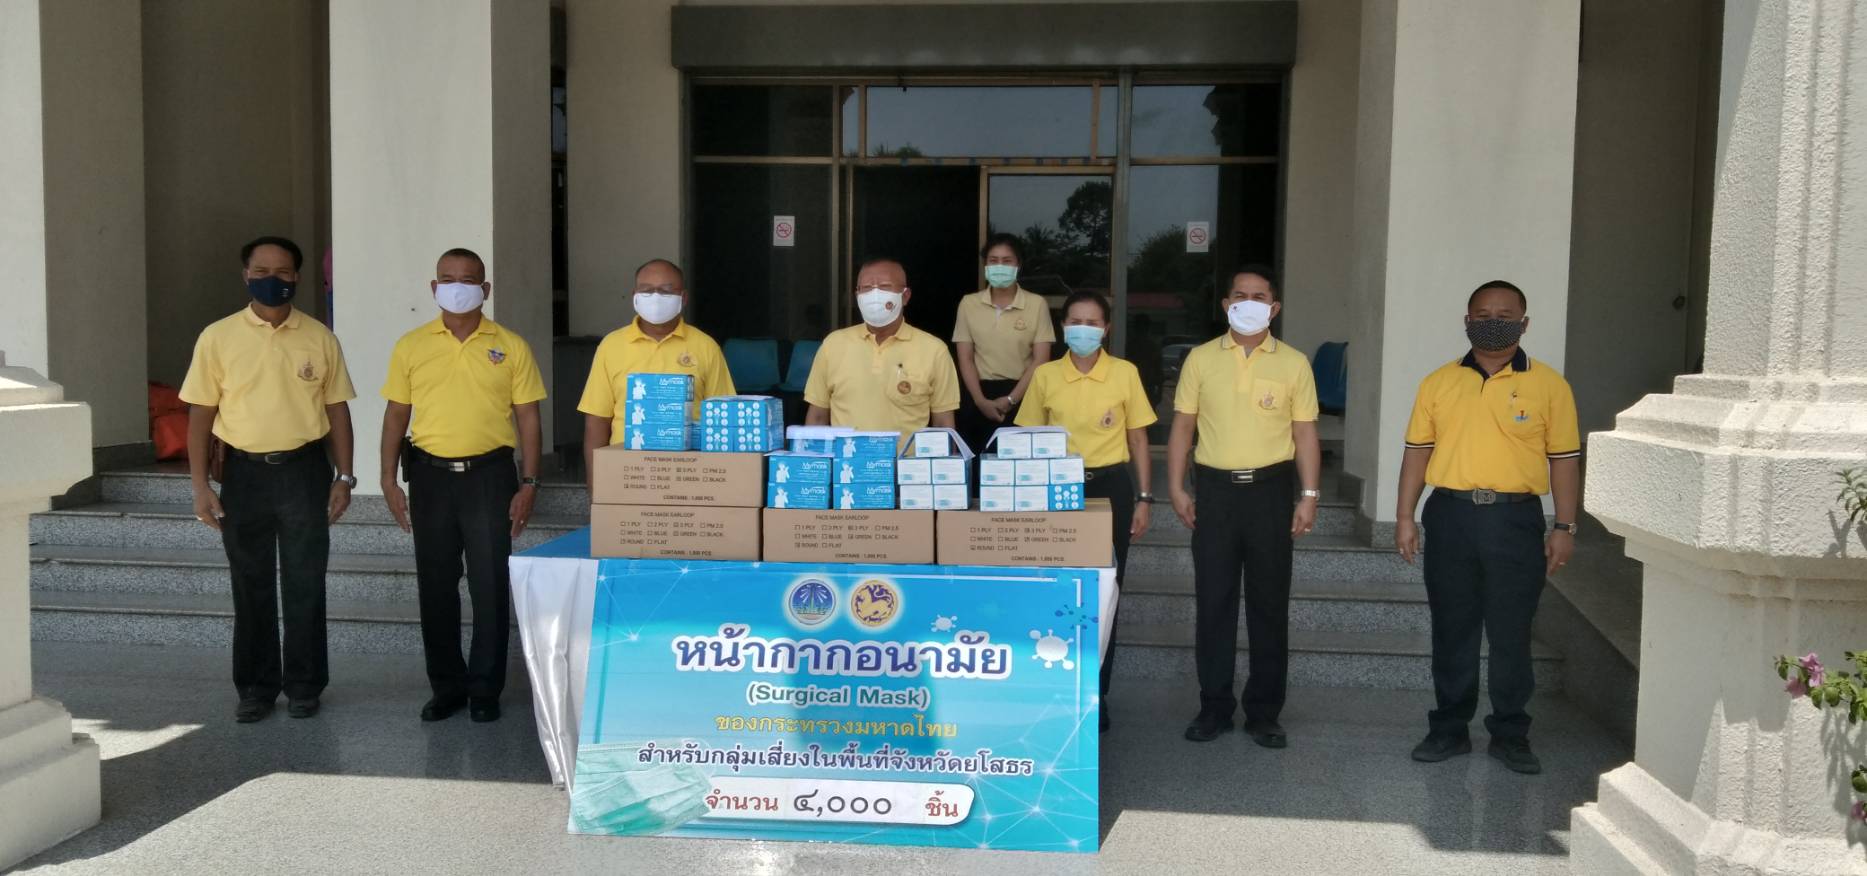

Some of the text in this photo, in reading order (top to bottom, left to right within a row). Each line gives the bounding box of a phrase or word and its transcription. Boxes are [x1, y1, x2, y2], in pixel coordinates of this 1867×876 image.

[677, 627, 1008, 674] หน้ากากอนามัย
[749, 684, 929, 708] (Surgical Mask)
[716, 714, 957, 737] ของกระทรวงมหาดไทย
[638, 741, 1033, 776] สำหรับกลุ่มเสี่ยงในพื้นที่จังหวัดยโสธร
[706, 789, 957, 817] จำนวน ๔,๐๐๐ ชิ้น
